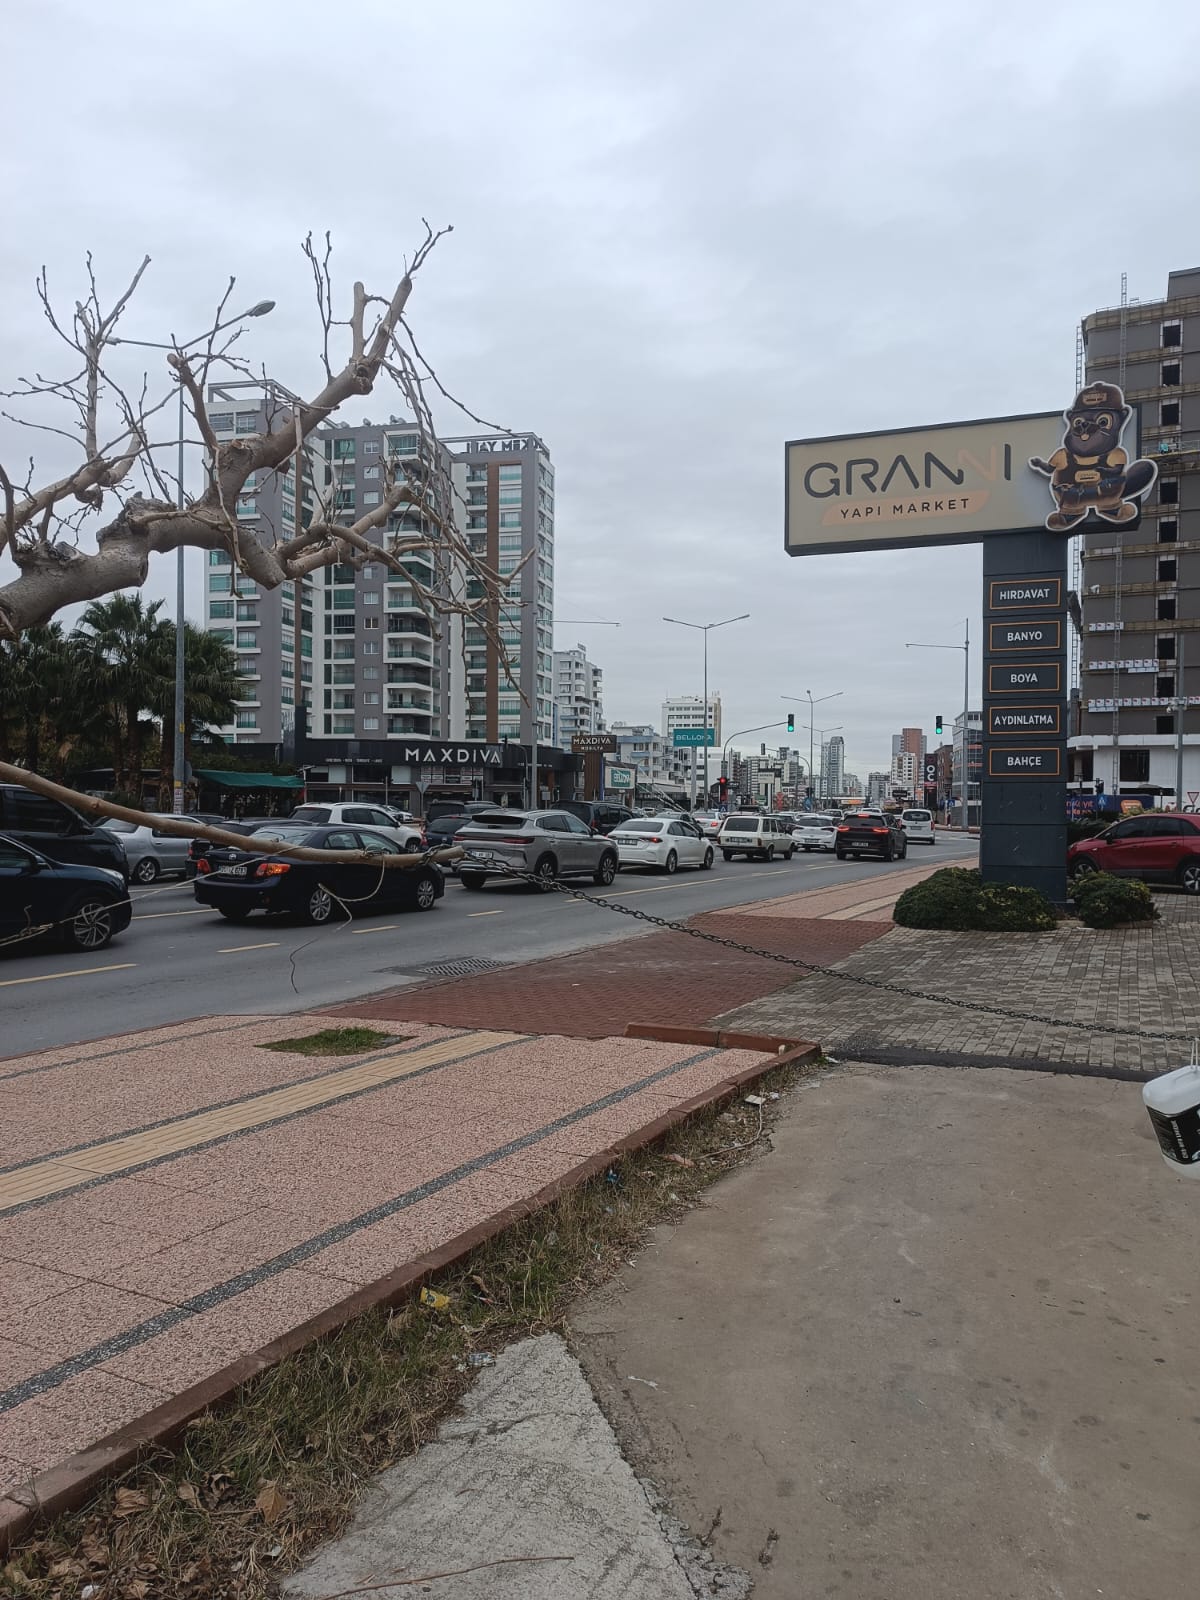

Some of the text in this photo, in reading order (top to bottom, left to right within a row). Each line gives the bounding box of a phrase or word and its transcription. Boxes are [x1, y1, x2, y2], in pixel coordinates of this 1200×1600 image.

[803, 443, 1012, 499] GRANNI
[840, 498, 970, 520] YAPI MARKET
[999, 588, 1051, 600] HIRDAVAT
[1007, 630, 1043, 642] BANYO
[1010, 673, 1038, 683] BOYA
[994, 714, 1054, 726] AYDINLATMA
[573, 737, 612, 745] MAXDIVA
[404, 748, 502, 764] MAXDIVA
[1007, 756, 1042, 768] BAHÇE
